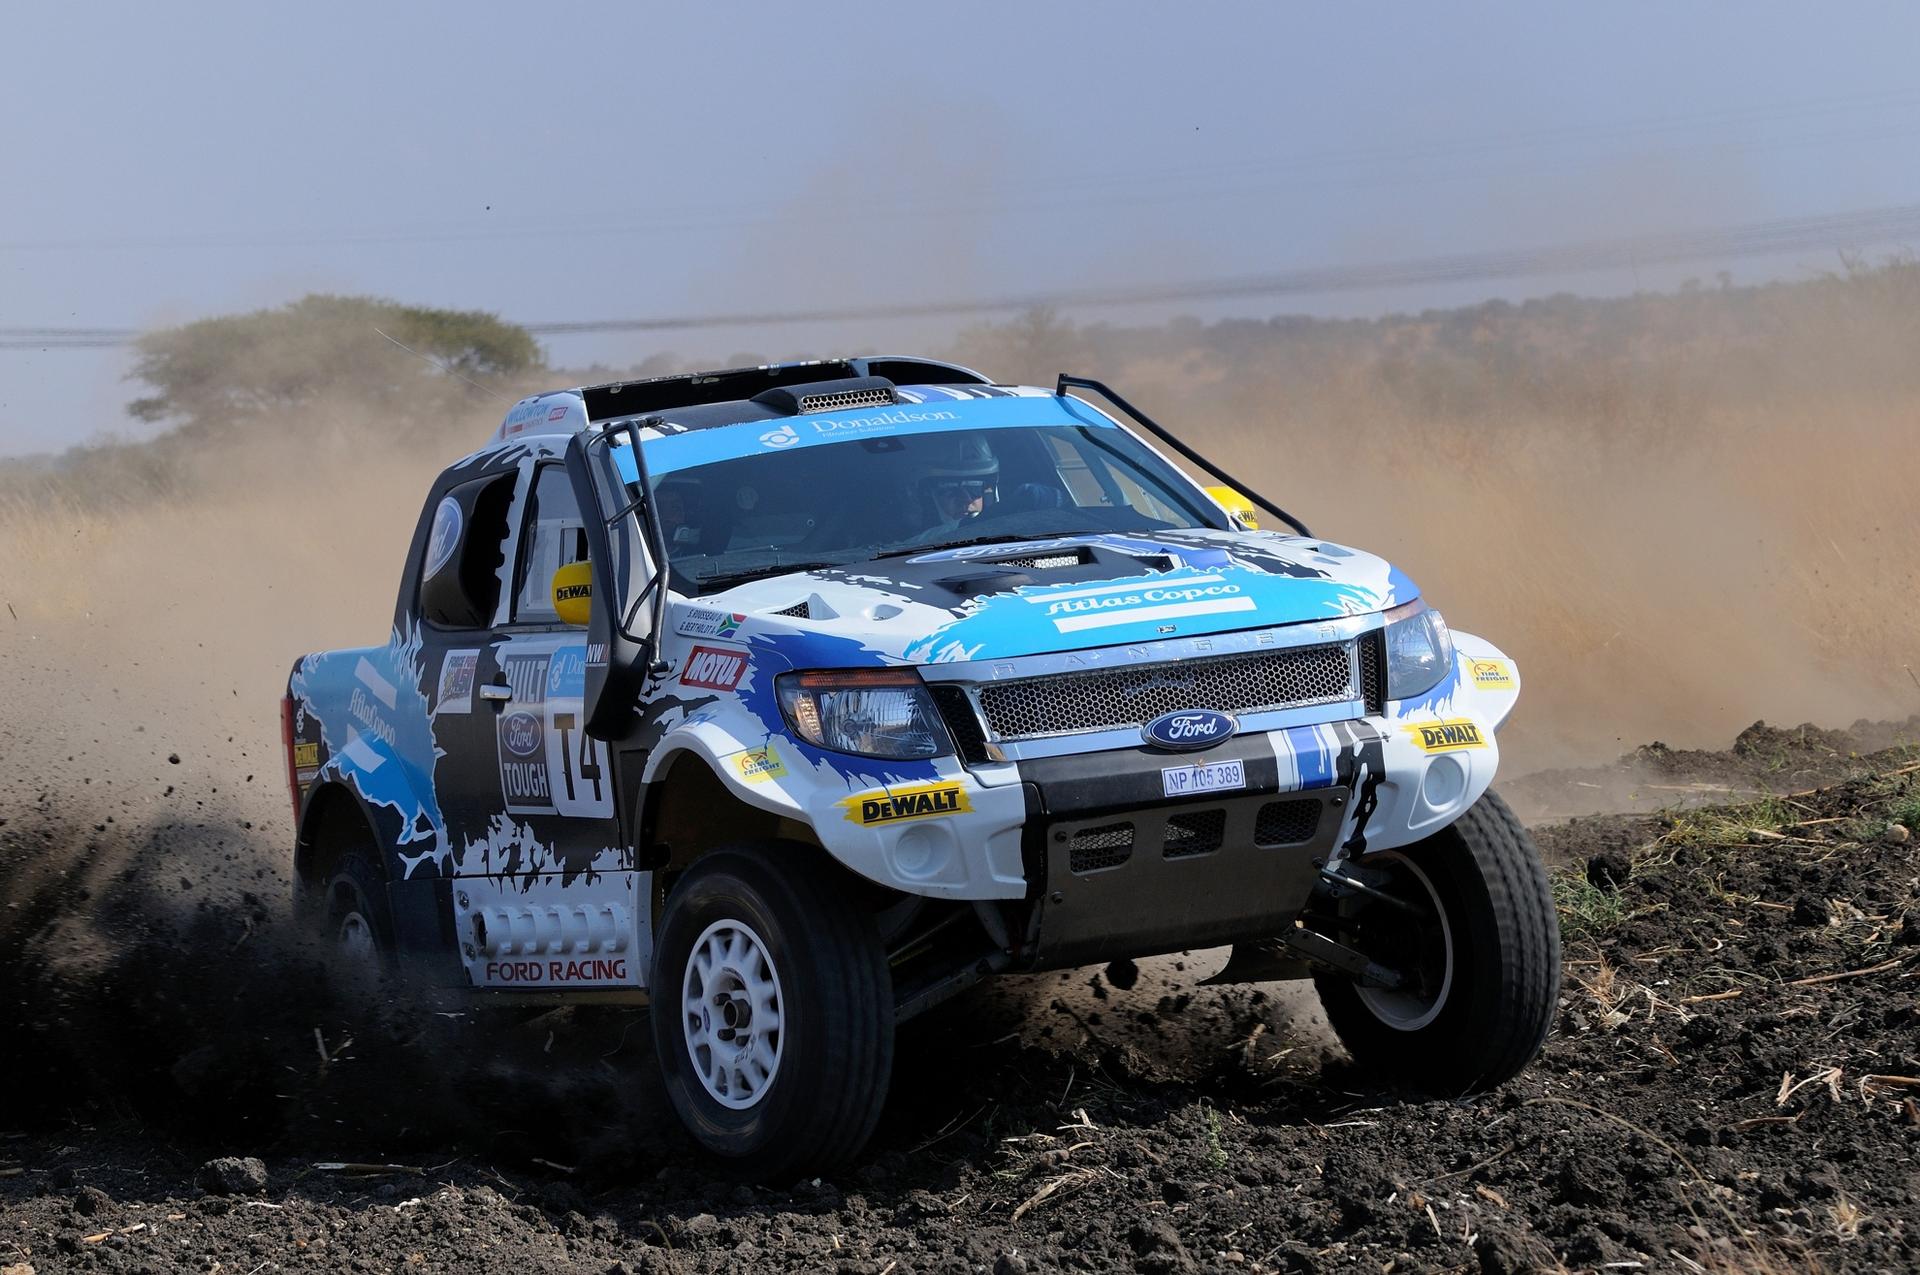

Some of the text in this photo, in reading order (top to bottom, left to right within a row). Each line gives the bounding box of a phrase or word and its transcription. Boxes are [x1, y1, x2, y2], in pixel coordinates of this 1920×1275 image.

[811, 411, 956, 433] Donaldson
[1045, 583, 1241, 616] Atlas Copco
[992, 625, 1336, 681] RANGER
[505, 660, 548, 704] BUILT
[684, 652, 742, 685] MOTUL
[509, 717, 534, 747] Ford
[1168, 714, 1218, 739] Ford
[1421, 725, 1480, 746] DEWALT
[744, 763, 780, 776] FREIGHT
[749, 760, 770, 769] TIME
[1168, 765, 1240, 791] NP 105 389
[504, 763, 549, 798] TOUGH
[862, 791, 960, 820] DEWALT
[486, 959, 626, 982] FORD RACING
